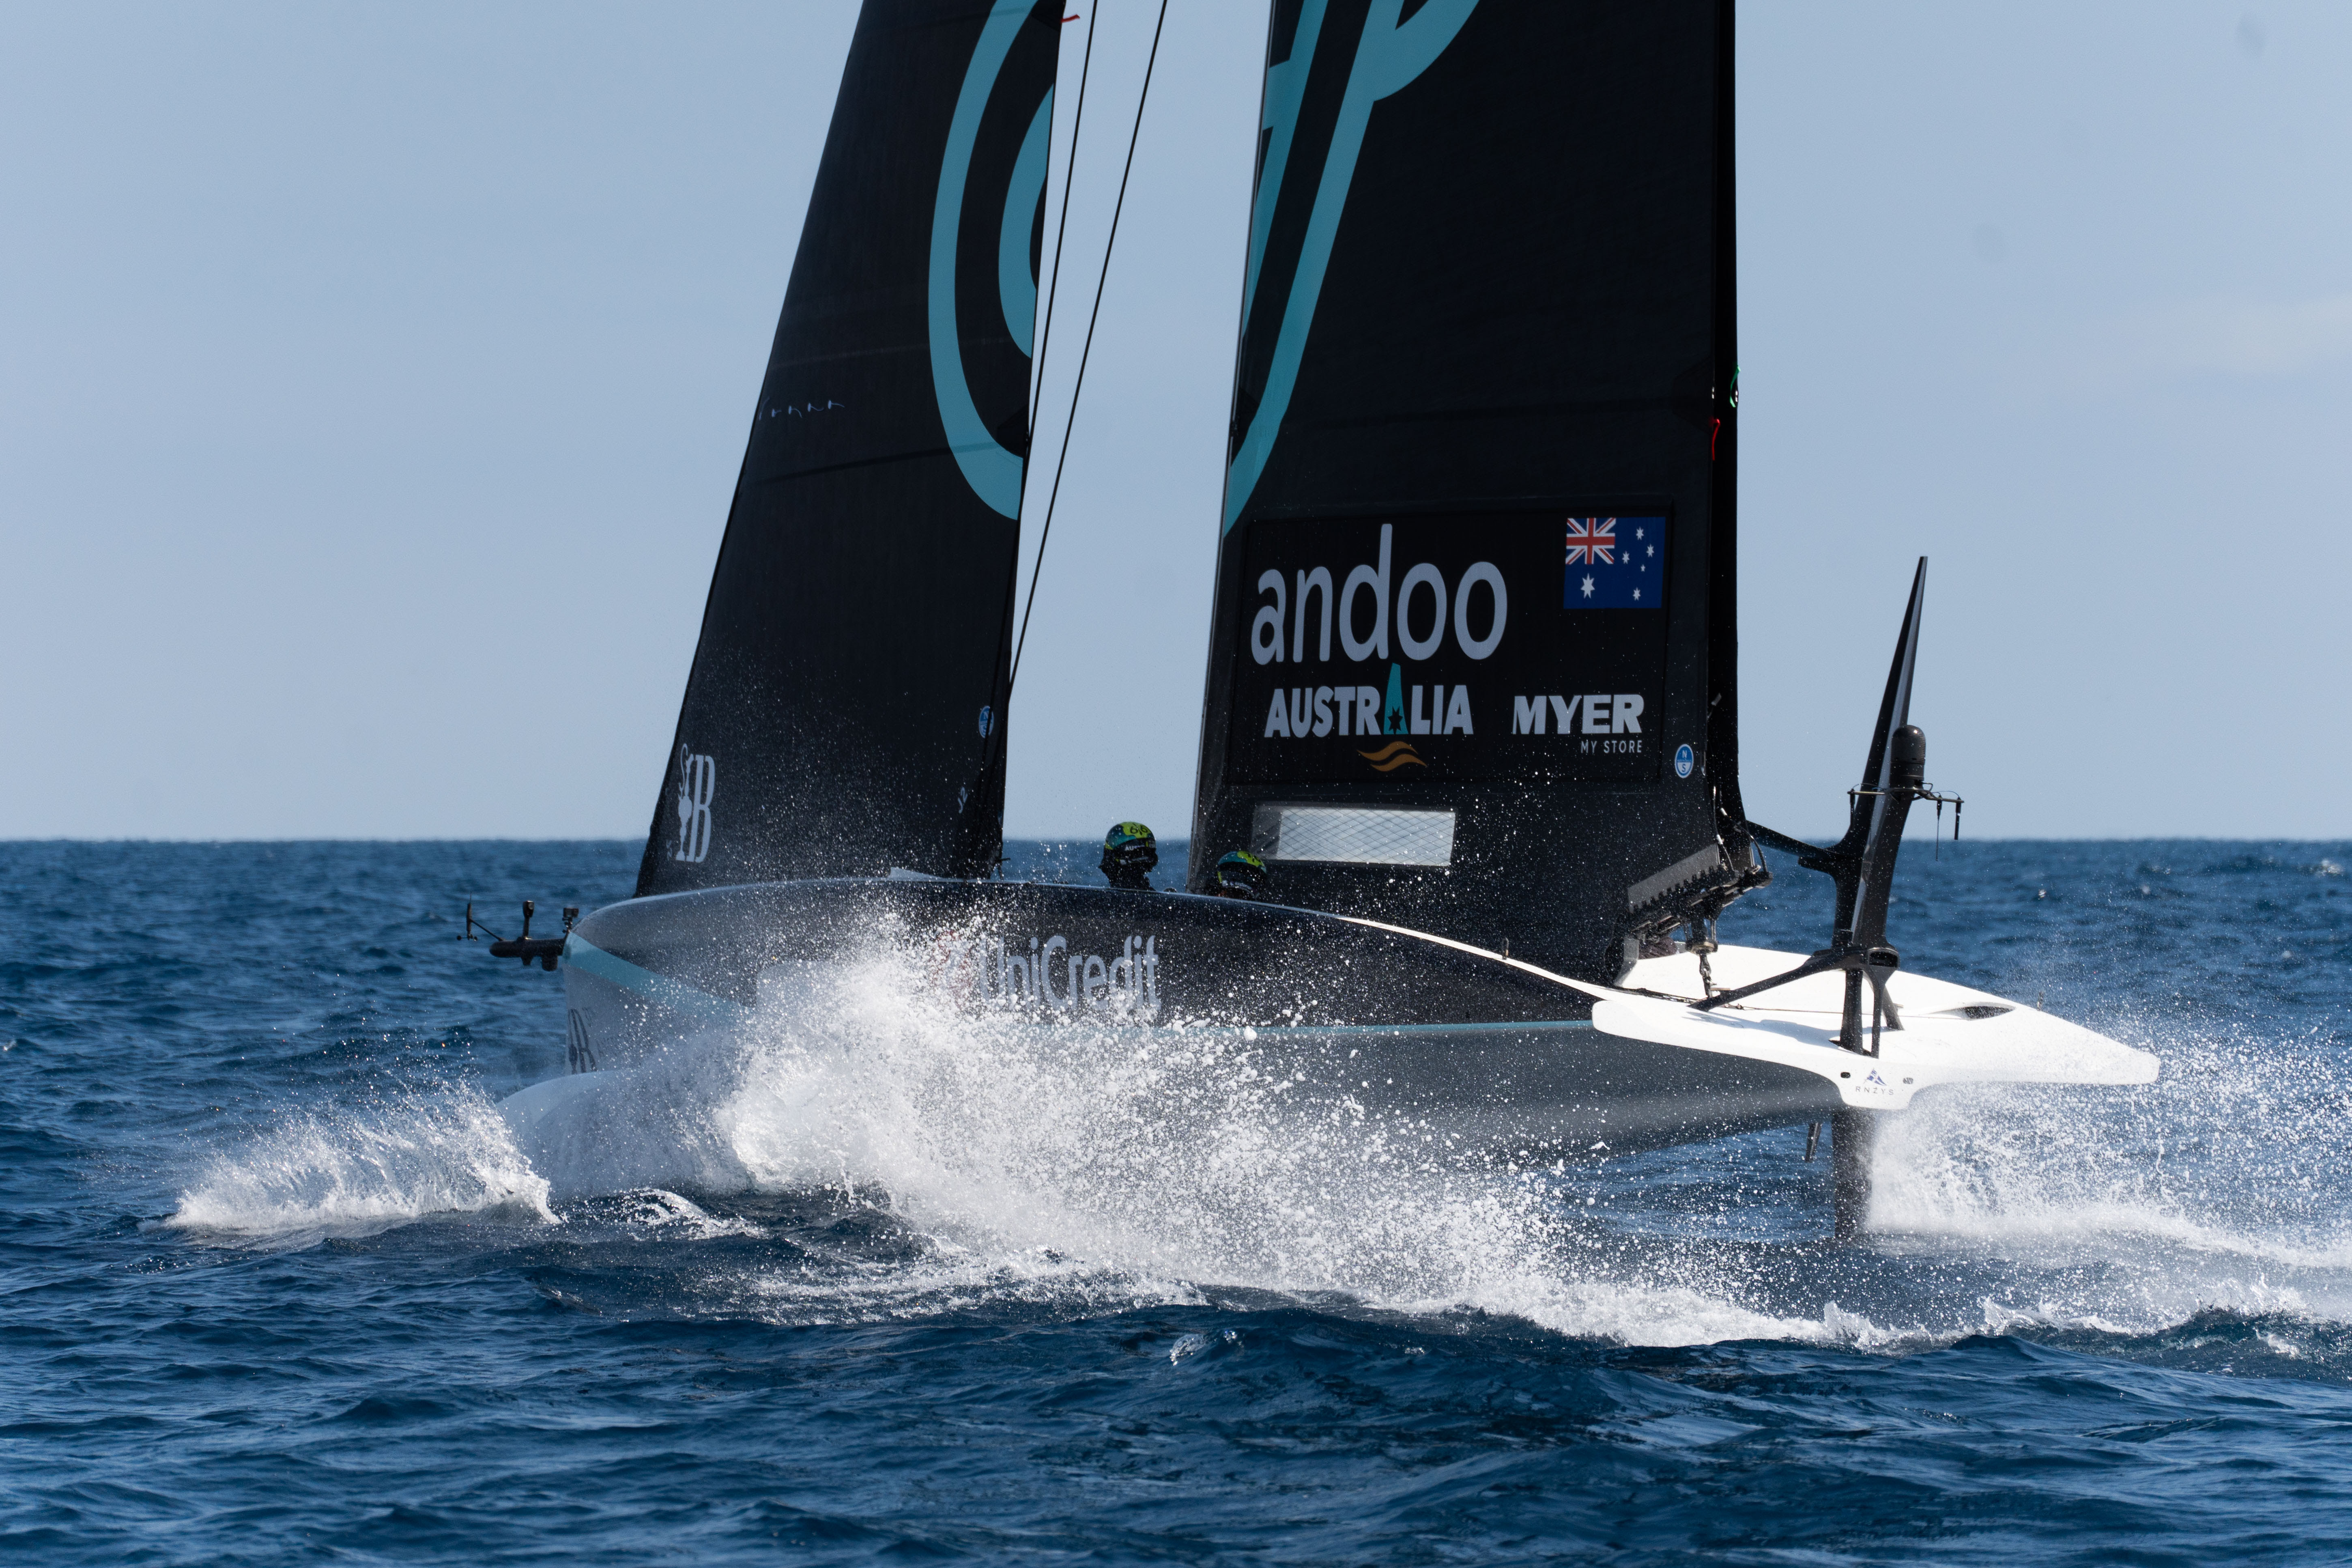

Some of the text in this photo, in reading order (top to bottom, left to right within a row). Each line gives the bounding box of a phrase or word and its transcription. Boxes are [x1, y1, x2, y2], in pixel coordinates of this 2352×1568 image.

[1251, 523, 1508, 665] andoo
[1264, 663, 1474, 738] AUSTRALIA
[1513, 694, 1645, 735] MYER
[1581, 740, 1643, 753] MY STORE
[978, 935, 1163, 1011] UniCredit
[1855, 1086, 1894, 1095] RNZYS
